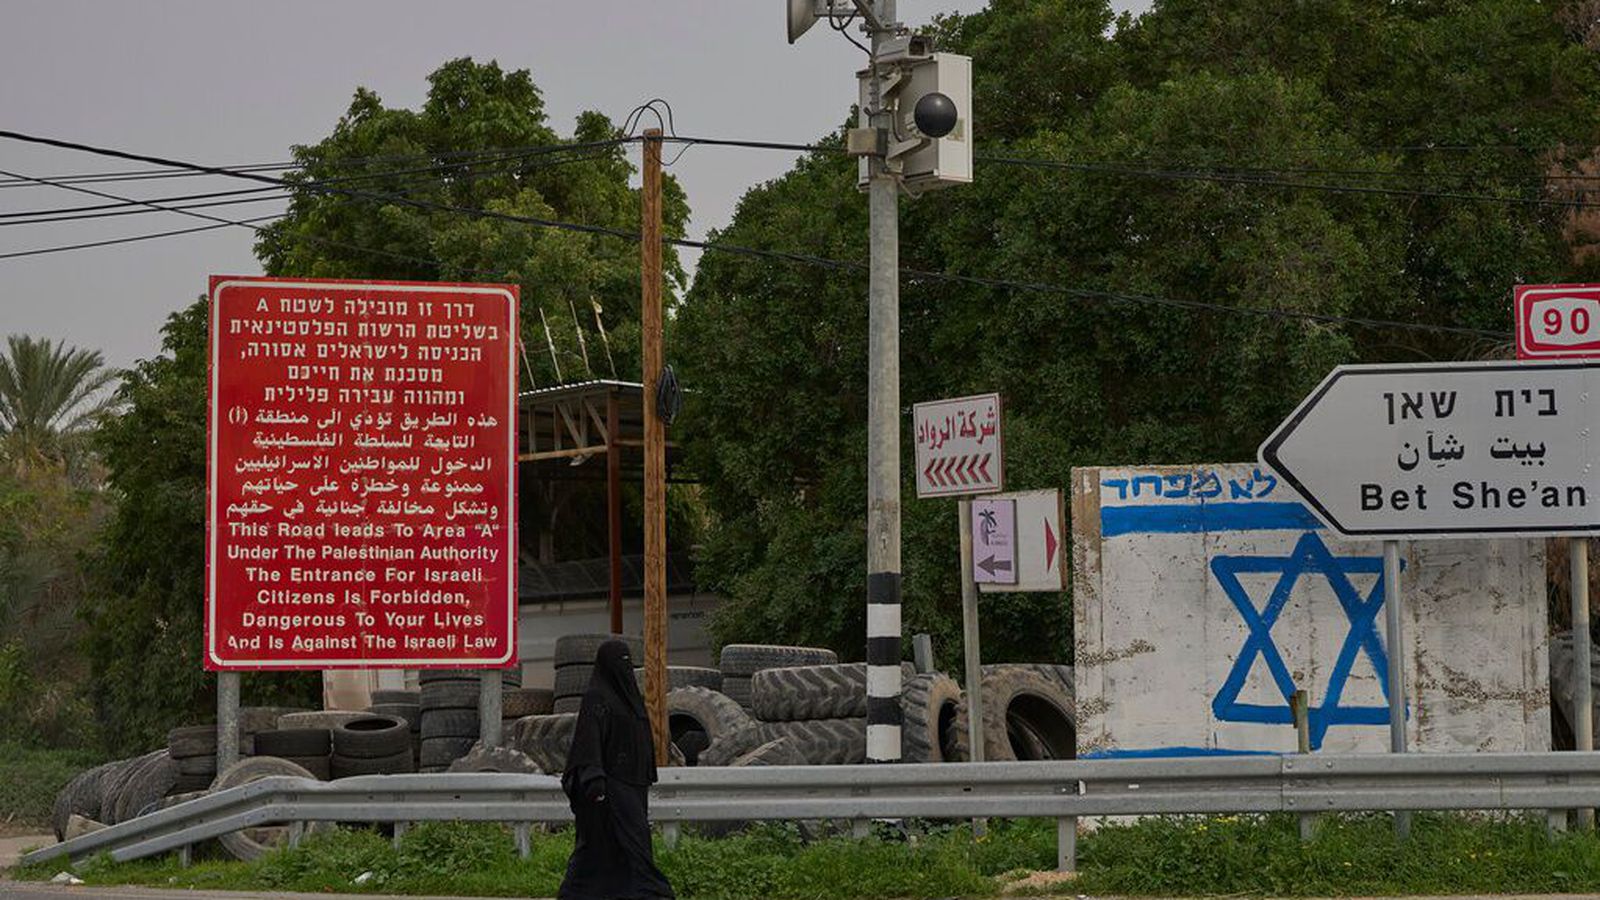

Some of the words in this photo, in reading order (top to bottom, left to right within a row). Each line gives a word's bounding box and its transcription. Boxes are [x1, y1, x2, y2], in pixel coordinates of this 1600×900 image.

[256, 298, 269, 312] A
[280, 297, 334, 313] לשטח
[345, 298, 407, 318] מובילה
[418, 302, 432, 316] זו
[443, 303, 474, 319] דרך
[230, 319, 347, 336] הפלסטינאית
[358, 322, 416, 338] הרשות
[1543, 308, 1590, 335] 90
[427, 323, 498, 340] בשליטת
[241, 342, 305, 359] אסורה,
[317, 342, 408, 359] לישראלים
[418, 346, 481, 361] הכניסה
[288, 365, 339, 381] חייכם
[350, 367, 374, 384] את
[385, 367, 442, 382] מסכנת
[265, 385, 328, 402] פלילית
[339, 389, 394, 403] עבירה
[404, 390, 464, 405] ומהווה
[1383, 391, 1457, 425] שאן
[1495, 389, 1558, 417] בית
[918, 411, 957, 449] الرواد
[960, 406, 995, 444] شركة
[1489, 437, 1546, 466] بيت
[1101, 471, 1223, 500] מפחד
[1228, 468, 1278, 500] לא
[1360, 484, 1427, 511] Bet
[1452, 481, 1586, 510] She'an
[229, 522, 269, 536] This
[278, 523, 324, 537] Road
[335, 523, 385, 537] leads
[392, 523, 414, 537] To
[423, 523, 466, 537] Area
[228, 545, 278, 559] Under
[284, 545, 316, 560] The
[322, 545, 415, 560] Palestinian
[420, 546, 498, 562] Authority
[246, 567, 280, 581] The
[291, 568, 375, 583] Entrance
[386, 568, 415, 582] For
[425, 568, 482, 583] Israeli
[257, 590, 335, 604] Citizens
[345, 590, 362, 606] Is
[371, 590, 470, 608] Forbidden,
[243, 613, 345, 630] Dangerous
[355, 612, 375, 626] To
[385, 612, 425, 628] Your
[435, 612, 483, 628] Lives
[228, 636, 260, 649] And
[269, 635, 283, 649] Is
[292, 635, 356, 652] Against
[364, 635, 396, 648] The
[405, 635, 456, 650] Israeli
[464, 635, 499, 650] Law
